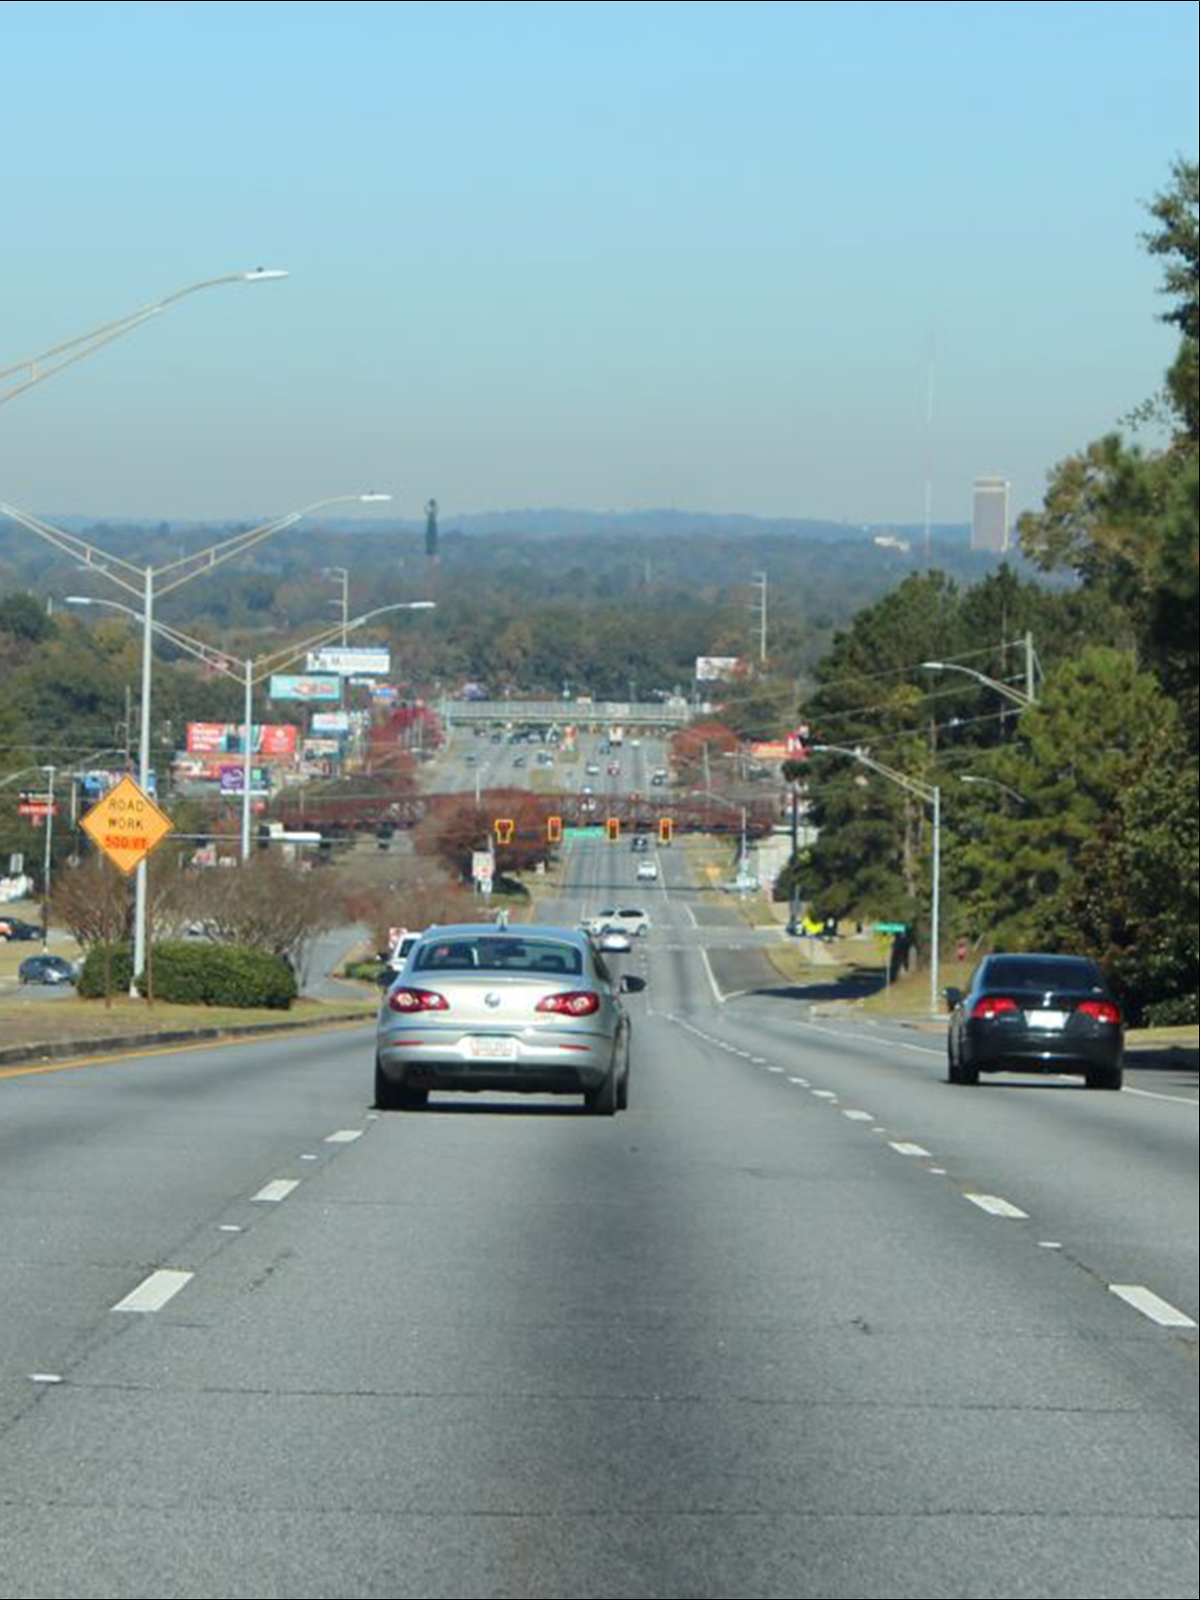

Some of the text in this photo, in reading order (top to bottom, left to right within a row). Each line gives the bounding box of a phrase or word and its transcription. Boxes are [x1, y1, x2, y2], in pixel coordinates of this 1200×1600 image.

[108, 798, 144, 812] ROAD
[108, 818, 143, 830] WORK
[105, 836, 129, 849] 500
